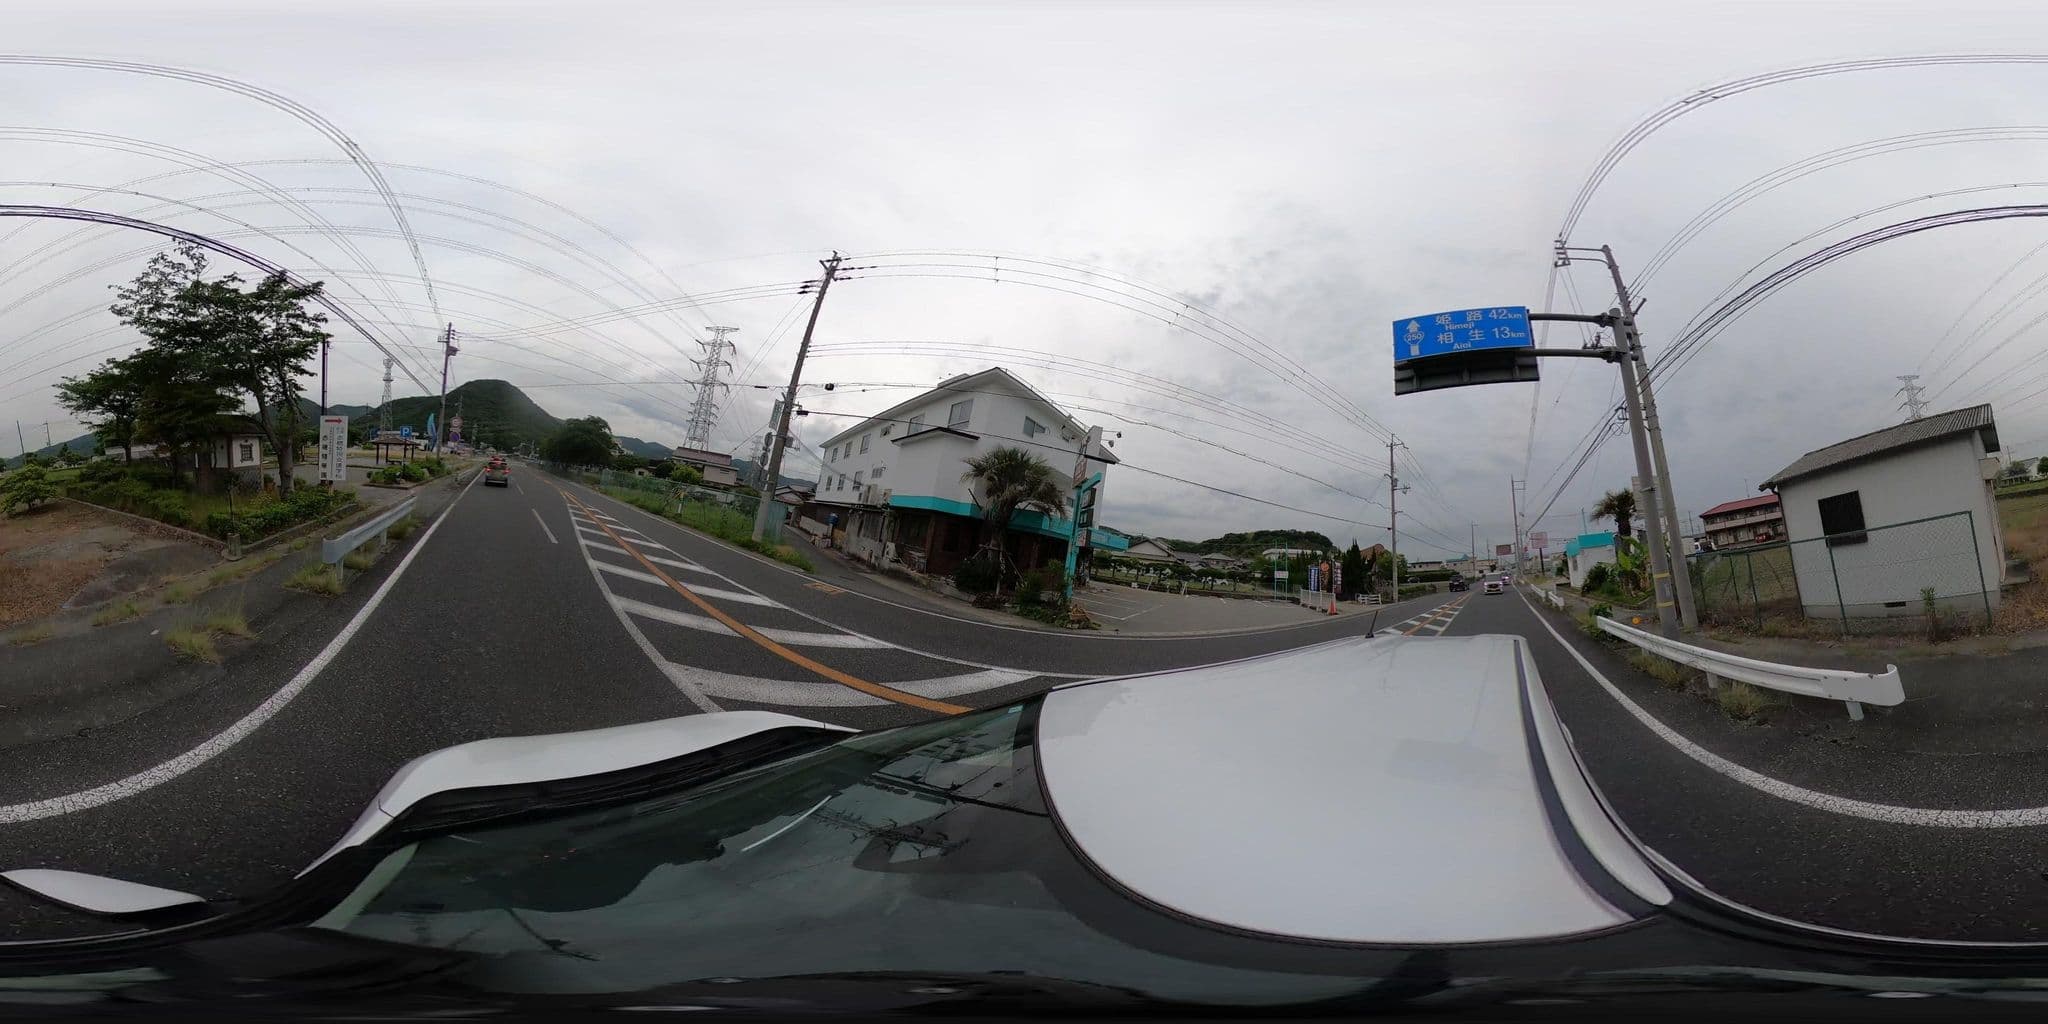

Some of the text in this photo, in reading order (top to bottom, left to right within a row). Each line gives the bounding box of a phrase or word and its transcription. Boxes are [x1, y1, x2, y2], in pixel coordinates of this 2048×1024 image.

[1445, 322, 1474, 331] Himeji
[1407, 334, 1422, 342] 250
[1437, 329, 1486, 344] 相生
[1453, 342, 1471, 350] Aioi
[402, 427, 409, 437] P
